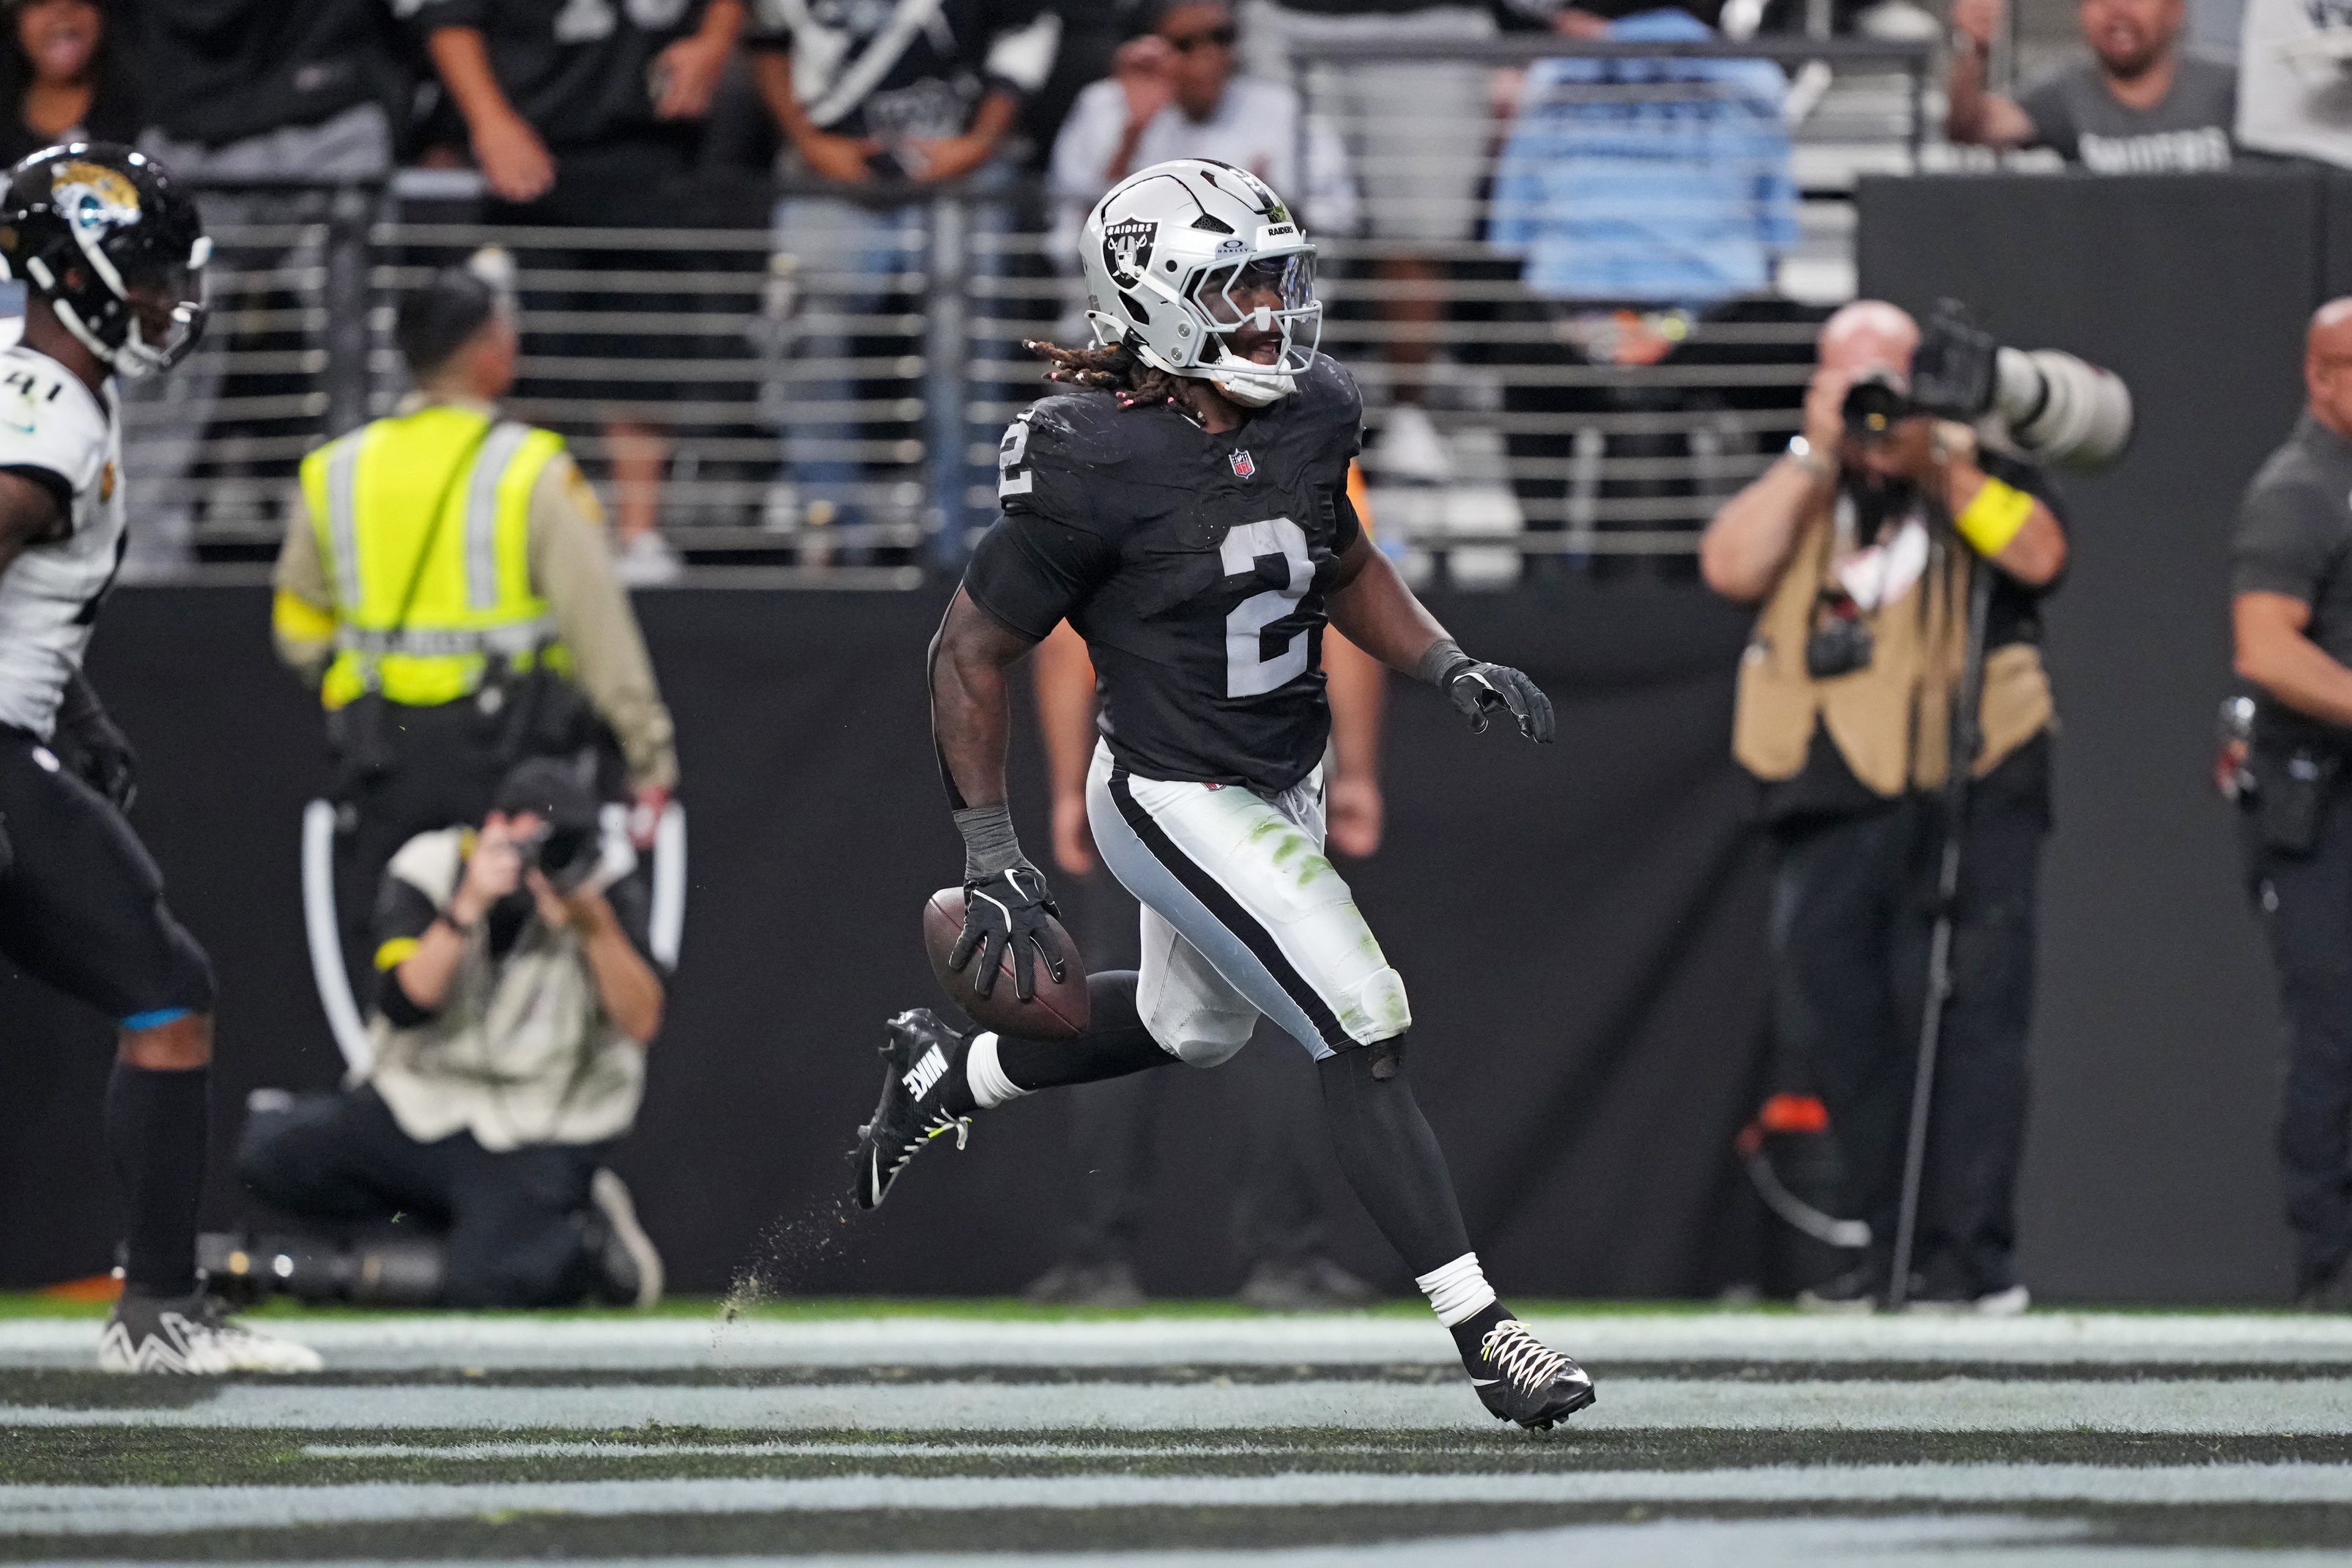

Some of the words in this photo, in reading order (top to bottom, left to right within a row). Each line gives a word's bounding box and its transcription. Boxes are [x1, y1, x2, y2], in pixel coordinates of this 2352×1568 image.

[1107, 223, 1152, 235] RAIDERS
[1268, 226, 1293, 236] RAIDERS
[4, 371, 62, 402] 41
[999, 420, 1032, 498] 2
[1235, 462, 1251, 474] NFL
[1220, 517, 1315, 698] 2
[901, 1042, 949, 1103] NIKE
